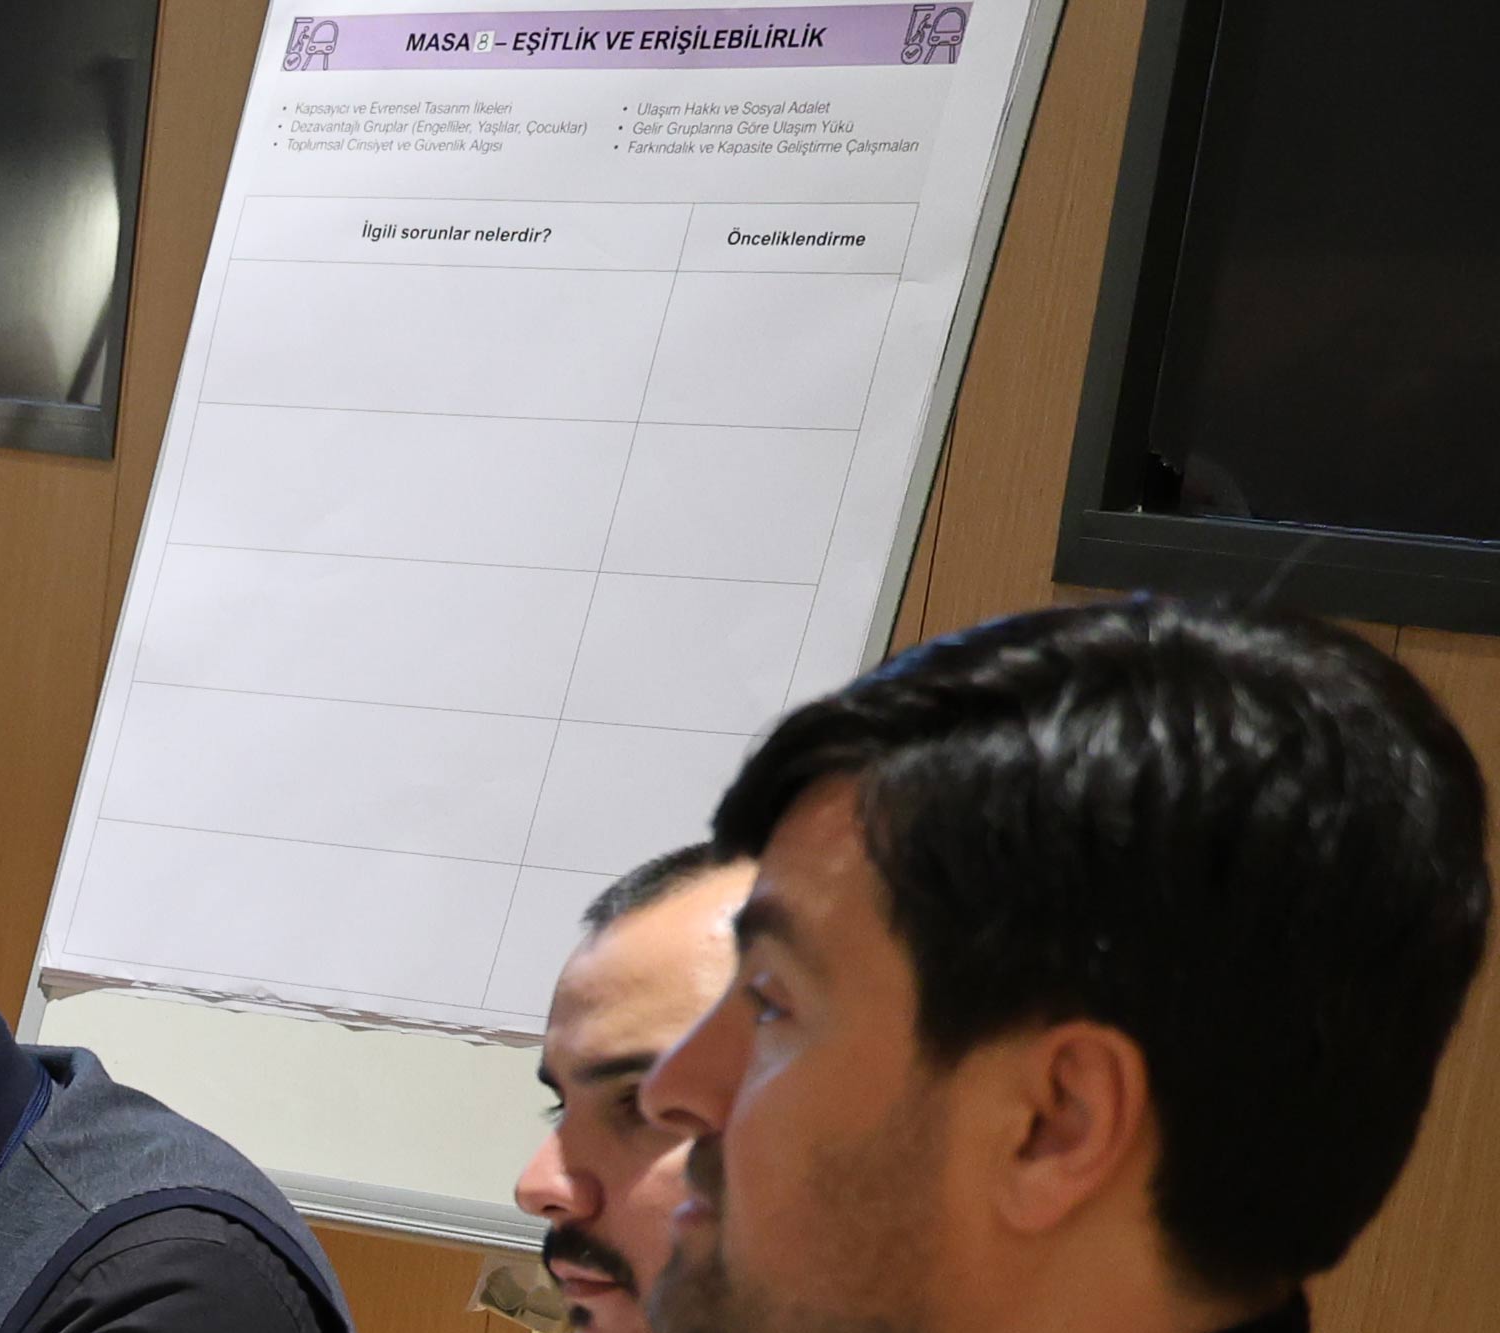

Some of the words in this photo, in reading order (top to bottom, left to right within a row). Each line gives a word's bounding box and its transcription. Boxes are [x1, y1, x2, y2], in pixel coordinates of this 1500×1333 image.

[405, 32, 471, 52] MASA
[476, 31, 489, 50] 8
[512, 26, 600, 56] EŞİTLİK
[605, 31, 634, 50] VE
[639, 23, 829, 55] ERİŞİLEBİLİRLİK
[294, 102, 350, 116] Kapsayıcı
[351, 105, 366, 115] ve
[370, 102, 420, 115] Evrensel
[637, 102, 681, 118] Ulaşım
[684, 102, 720, 115] Hakkı
[723, 105, 739, 115] ve
[742, 102, 786, 118] Sosyal
[790, 101, 831, 115] Adalet
[290, 121, 361, 135] Dezavantajlı
[363, 121, 408, 136] Gruplar
[526, 121, 588, 136] Çocuklar)
[632, 121, 664, 135] Gelir
[667, 121, 733, 138] Gruplarına
[736, 121, 769, 135] Göre
[773, 120, 817, 137] Ulaşım
[821, 120, 854, 134] Yükü
[287, 139, 344, 153] Toplumsal
[347, 139, 394, 153] Cinsiyet
[397, 141, 411, 151] ve
[414, 139, 467, 152] Güvenlik
[469, 139, 503, 154] Algısı
[627, 141, 696, 155] Farkındalık
[699, 144, 714, 154] ve
[718, 140, 773, 157] Kapasite
[777, 139, 842, 156] Geliştirme
[361, 220, 398, 242] İlgili
[399, 224, 471, 241] sorunlar
[474, 227, 552, 244] nelerdir?
[726, 227, 866, 247] Önceliklendirme
